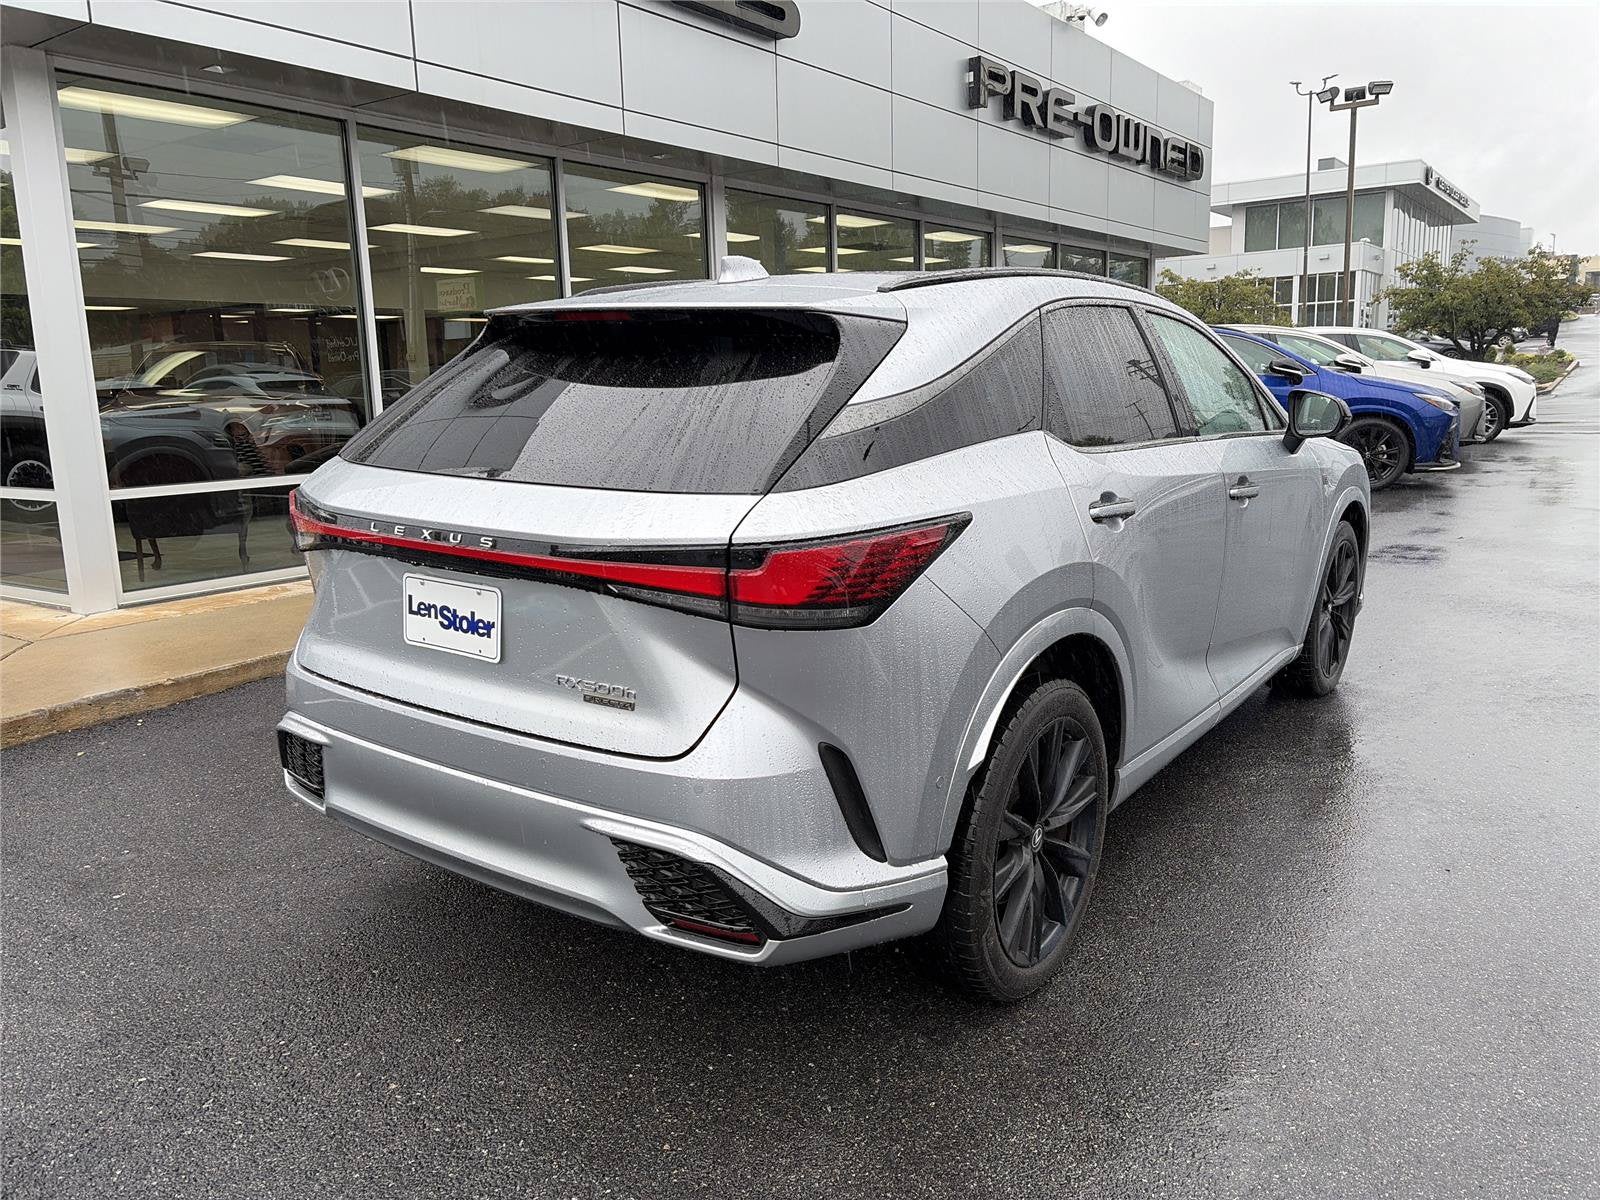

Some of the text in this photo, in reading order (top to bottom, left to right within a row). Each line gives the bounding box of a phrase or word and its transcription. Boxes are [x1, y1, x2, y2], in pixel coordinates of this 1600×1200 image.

[969, 56, 1204, 181] PRE-OWNED
[370, 521, 494, 549] LEXUS
[408, 594, 495, 639] Len Stoler
[556, 674, 637, 700] RX500h
